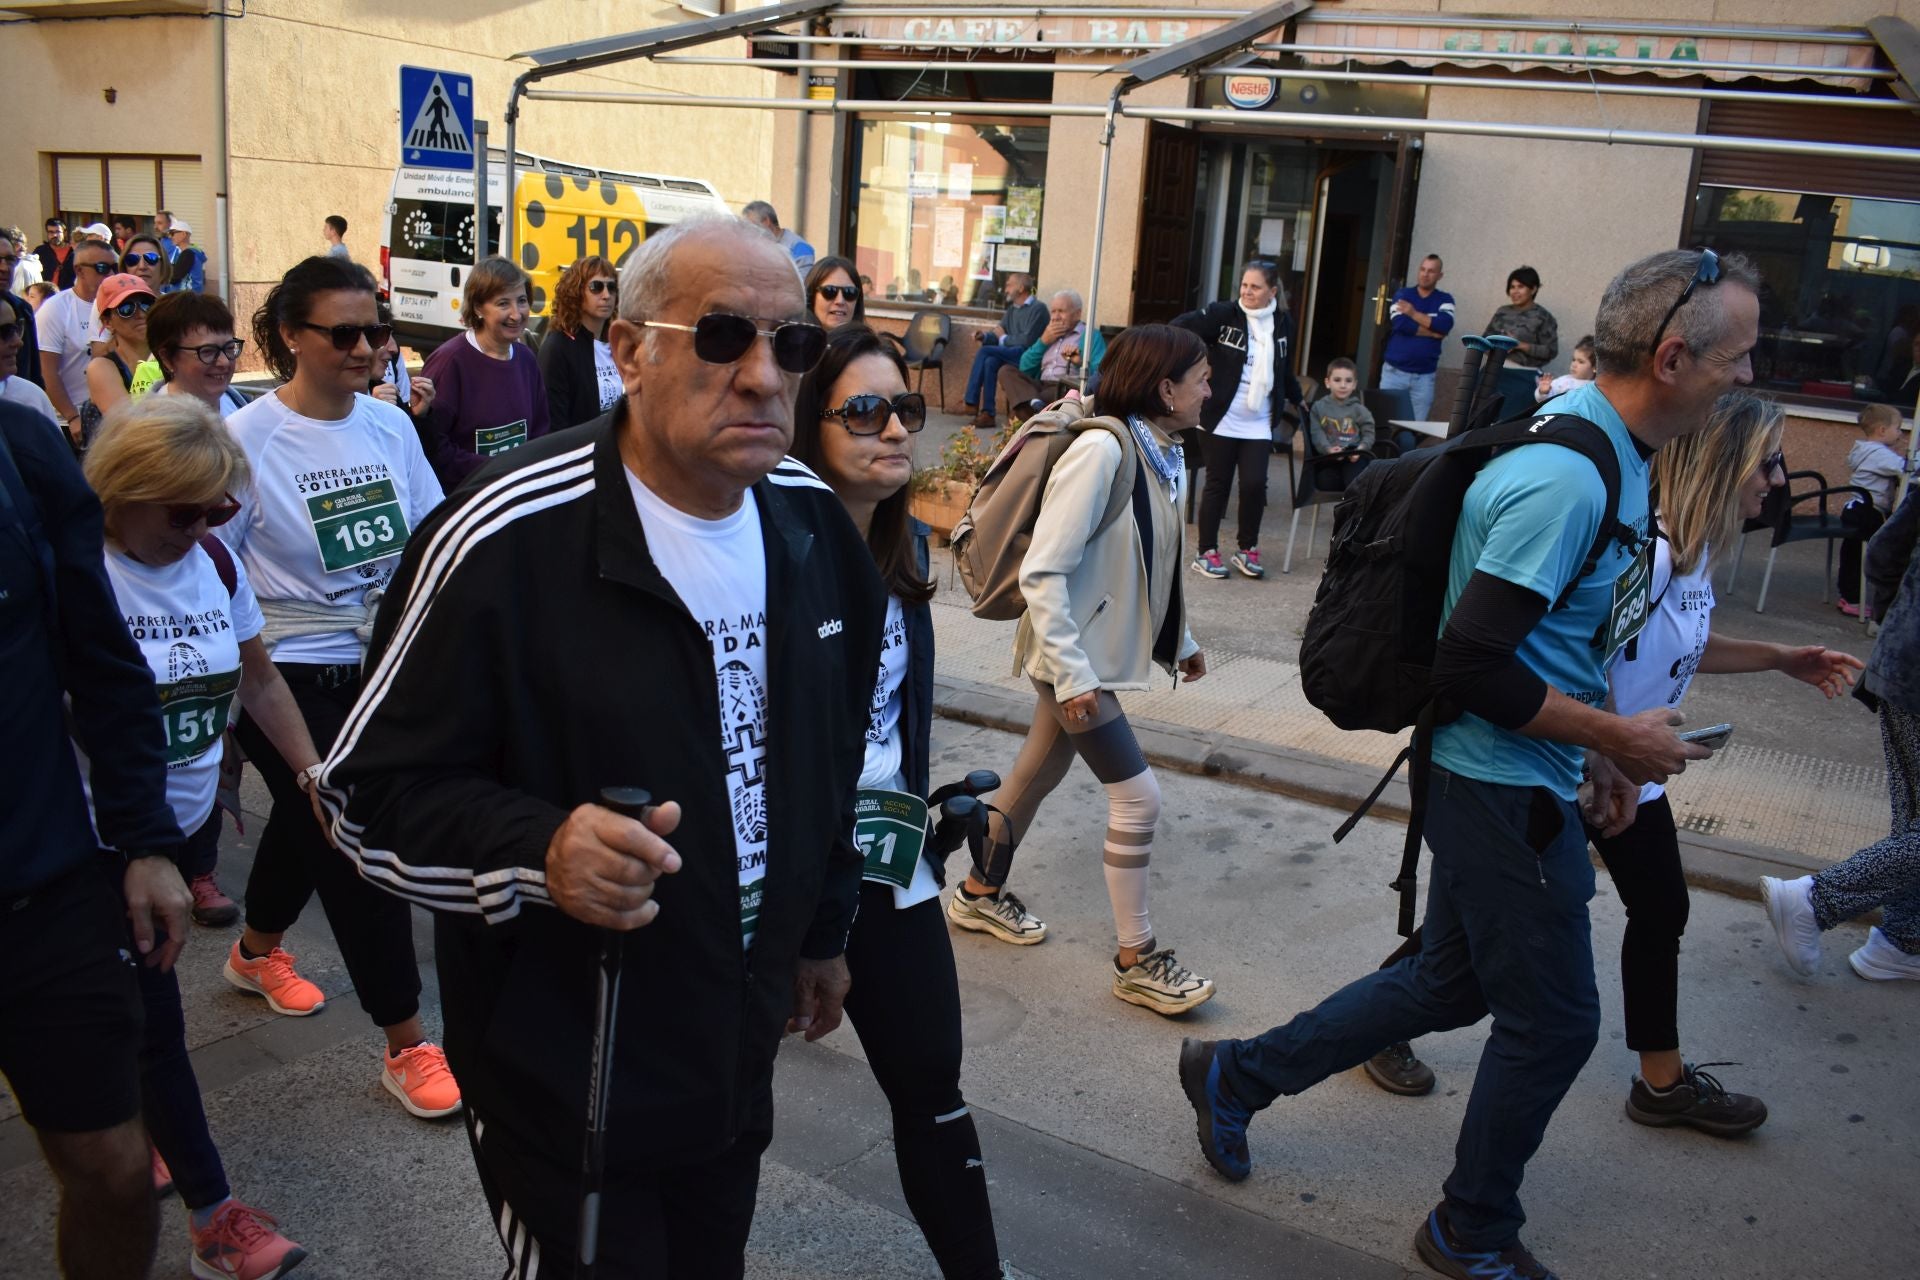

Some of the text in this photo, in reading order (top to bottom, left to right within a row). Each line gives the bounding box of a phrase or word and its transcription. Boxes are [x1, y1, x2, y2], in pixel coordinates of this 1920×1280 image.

[1088, 20, 1190, 44] BAR
[1444, 31, 1699, 61] GLORIA
[404, 172, 426, 180] Unidad
[456, 176, 498, 186] Emerias
[417, 187, 474, 197] ambulanci
[414, 221, 432, 235] 112
[567, 215, 640, 271] 112
[295, 463, 388, 483] CARRERA-MARCHA
[336, 515, 395, 552] 163
[127, 609, 225, 626] ARRERA-MARCHA
[1615, 587, 1646, 639] 689
[133, 619, 230, 640] OLIDARIA
[818, 619, 842, 639] adida
